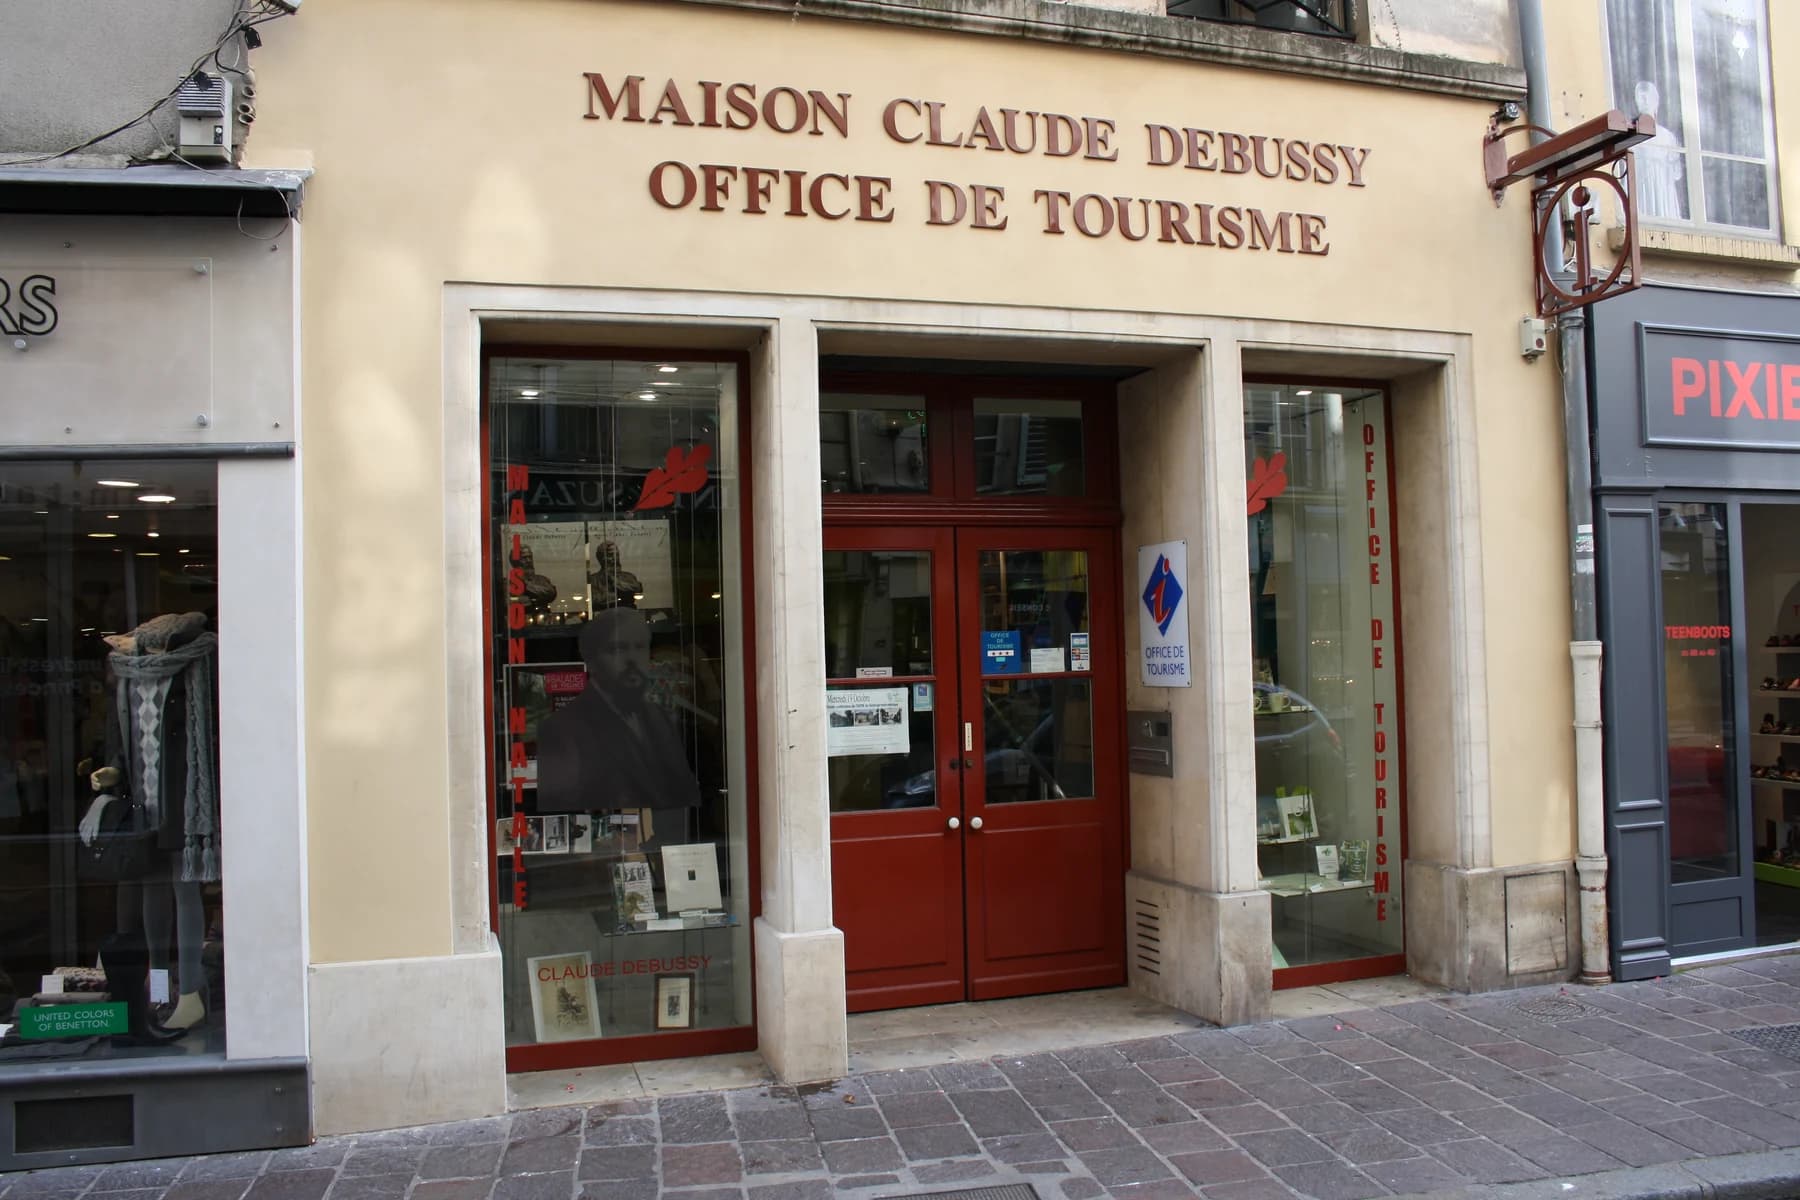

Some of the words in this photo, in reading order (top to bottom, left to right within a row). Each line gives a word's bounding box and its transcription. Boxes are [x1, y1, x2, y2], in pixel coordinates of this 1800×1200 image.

[583, 72, 851, 138] MAISON
[883, 98, 1119, 162] CLAUDE
[1145, 122, 1371, 188] DEBUSSY
[649, 160, 895, 223] OFFICE
[925, 180, 1008, 231] DE
[1034, 189, 1330, 257] TOURISME
[1362, 424, 1381, 585] OFFICE
[506, 465, 529, 665] MAISON
[1145, 646, 1173, 660] OFFICE
[1174, 645, 1185, 658] DE
[1371, 619, 1384, 669] DE
[1664, 625, 1731, 640] TEENBOOTS
[1146, 663, 1185, 676] TOURISME
[509, 707, 528, 909] NATALE
[1373, 703, 1390, 922] TOURISME
[537, 962, 616, 983] CLAUDE
[621, 955, 714, 976] DEBUSSY
[33, 1010, 71, 1023] UNITED
[74, 1009, 115, 1020] COLORS
[38, 1022, 52, 1032] OF
